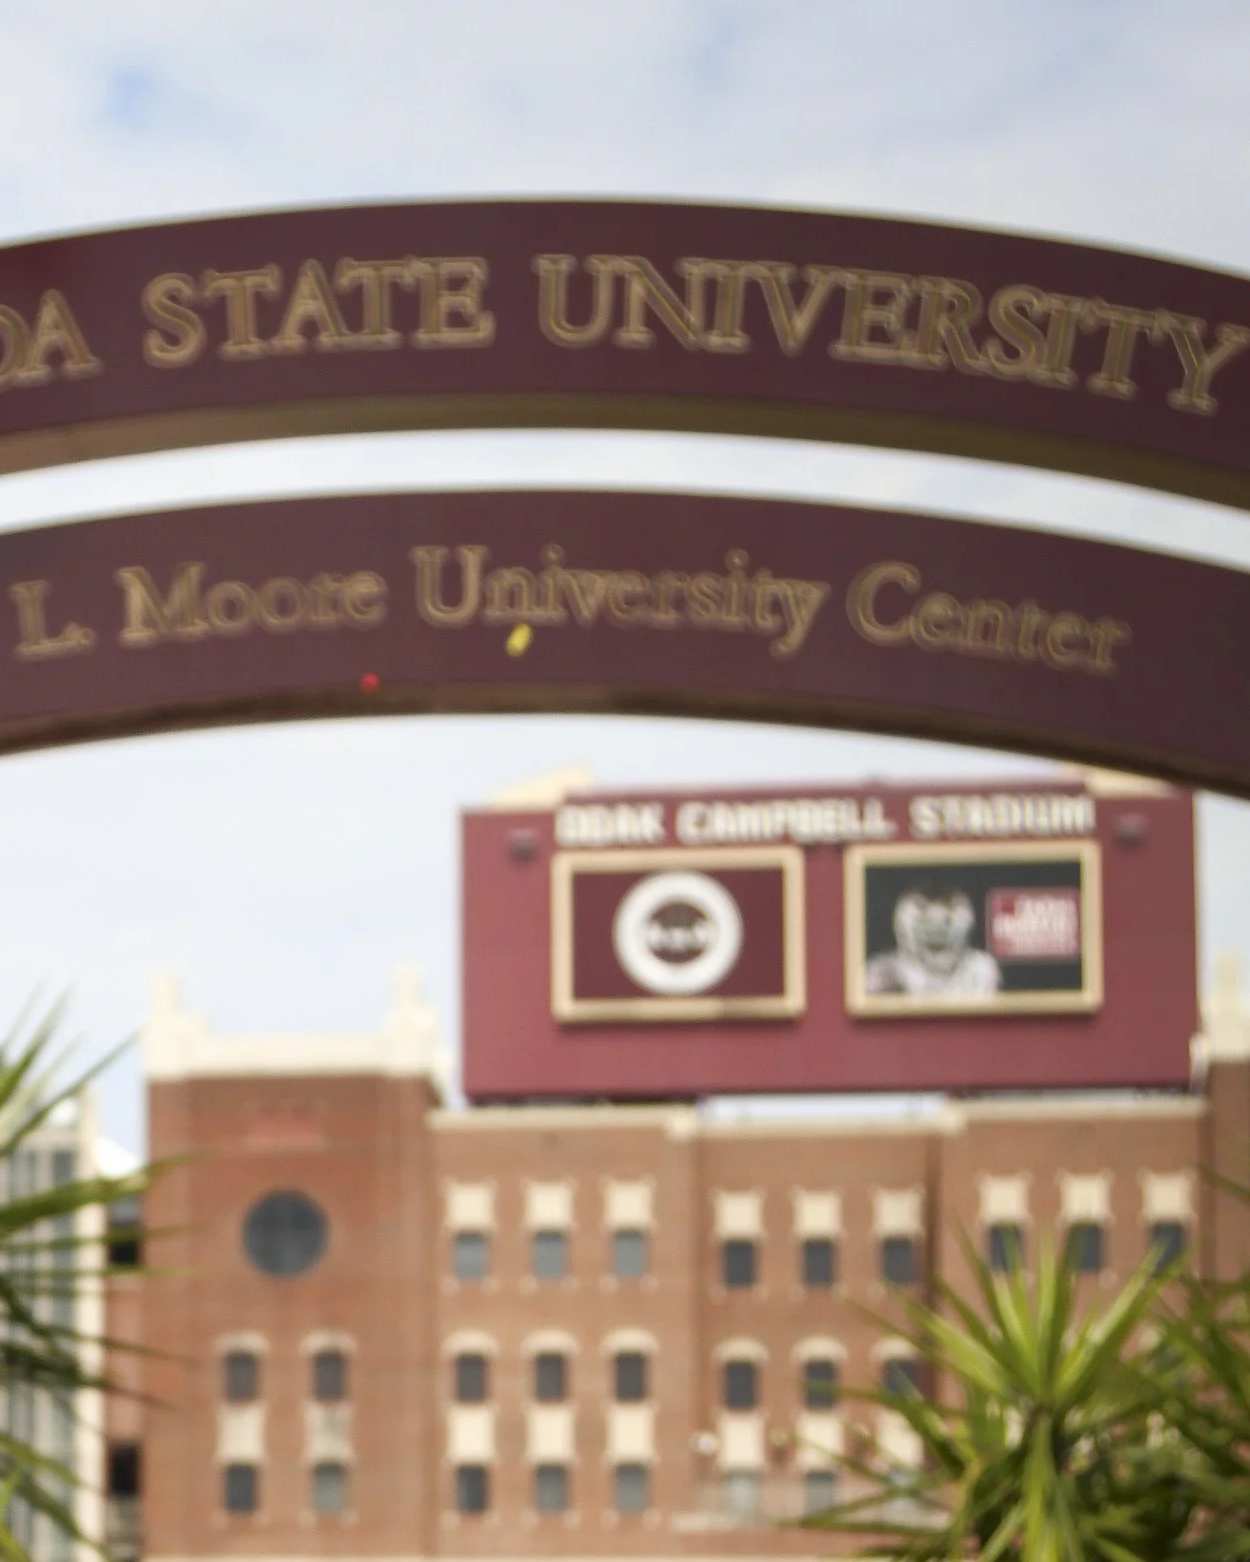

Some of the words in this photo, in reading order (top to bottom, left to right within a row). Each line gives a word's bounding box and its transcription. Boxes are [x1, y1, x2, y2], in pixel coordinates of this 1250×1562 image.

[141, 255, 495, 368] STATE
[532, 254, 1250, 415] UNIVERSITY
[9, 578, 95, 657] L.
[115, 561, 388, 648] Moore
[409, 544, 832, 658] University
[847, 560, 1132, 675] Center
[674, 797, 896, 846] CAMPBELL
[909, 793, 1096, 841] STADIUM
